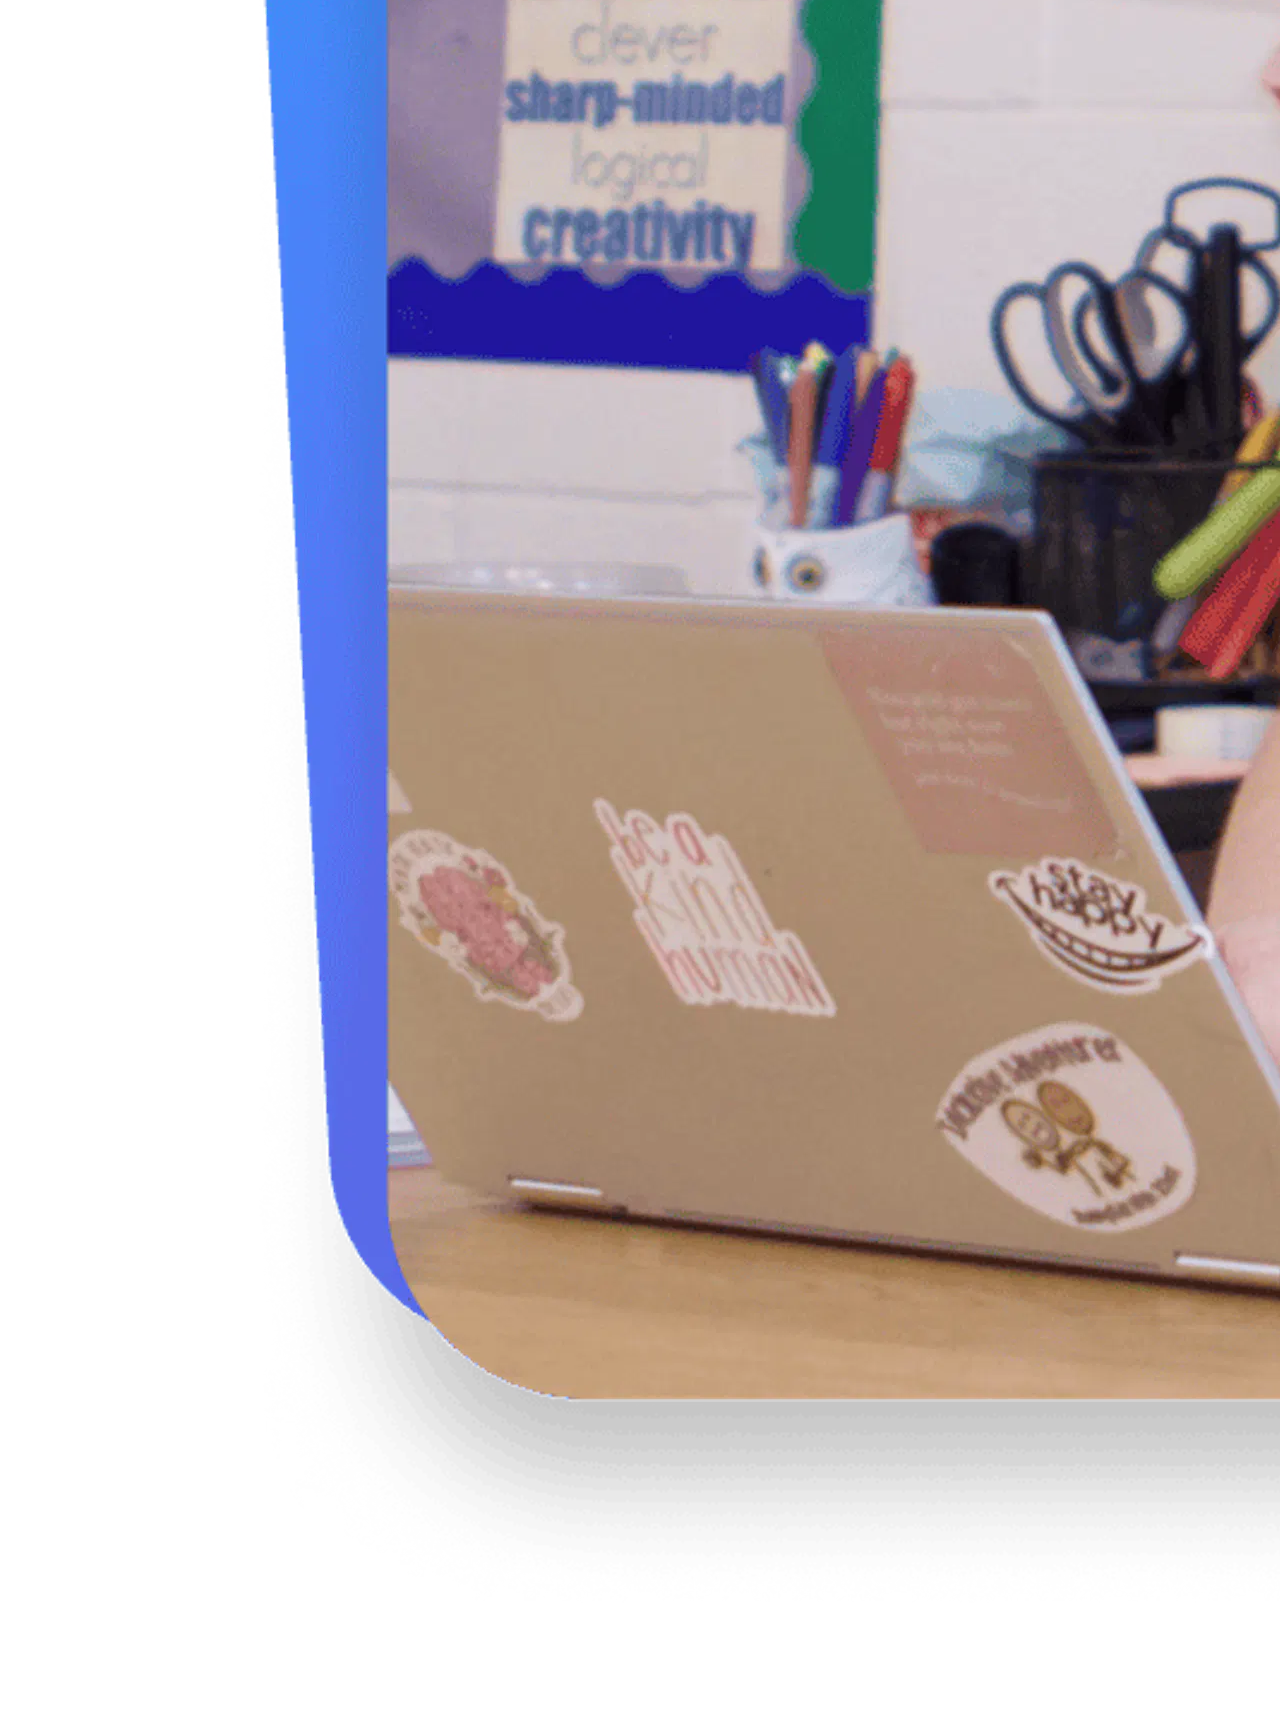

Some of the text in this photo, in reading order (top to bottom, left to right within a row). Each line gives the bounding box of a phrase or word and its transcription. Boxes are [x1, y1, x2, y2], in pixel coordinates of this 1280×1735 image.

[570, 1, 720, 65] clever
[504, 70, 785, 129] sharp-minded
[571, 129, 709, 201] logical
[522, 199, 755, 265] creativity
[1028, 872, 1164, 949] happy
[1047, 863, 1137, 917] stay
